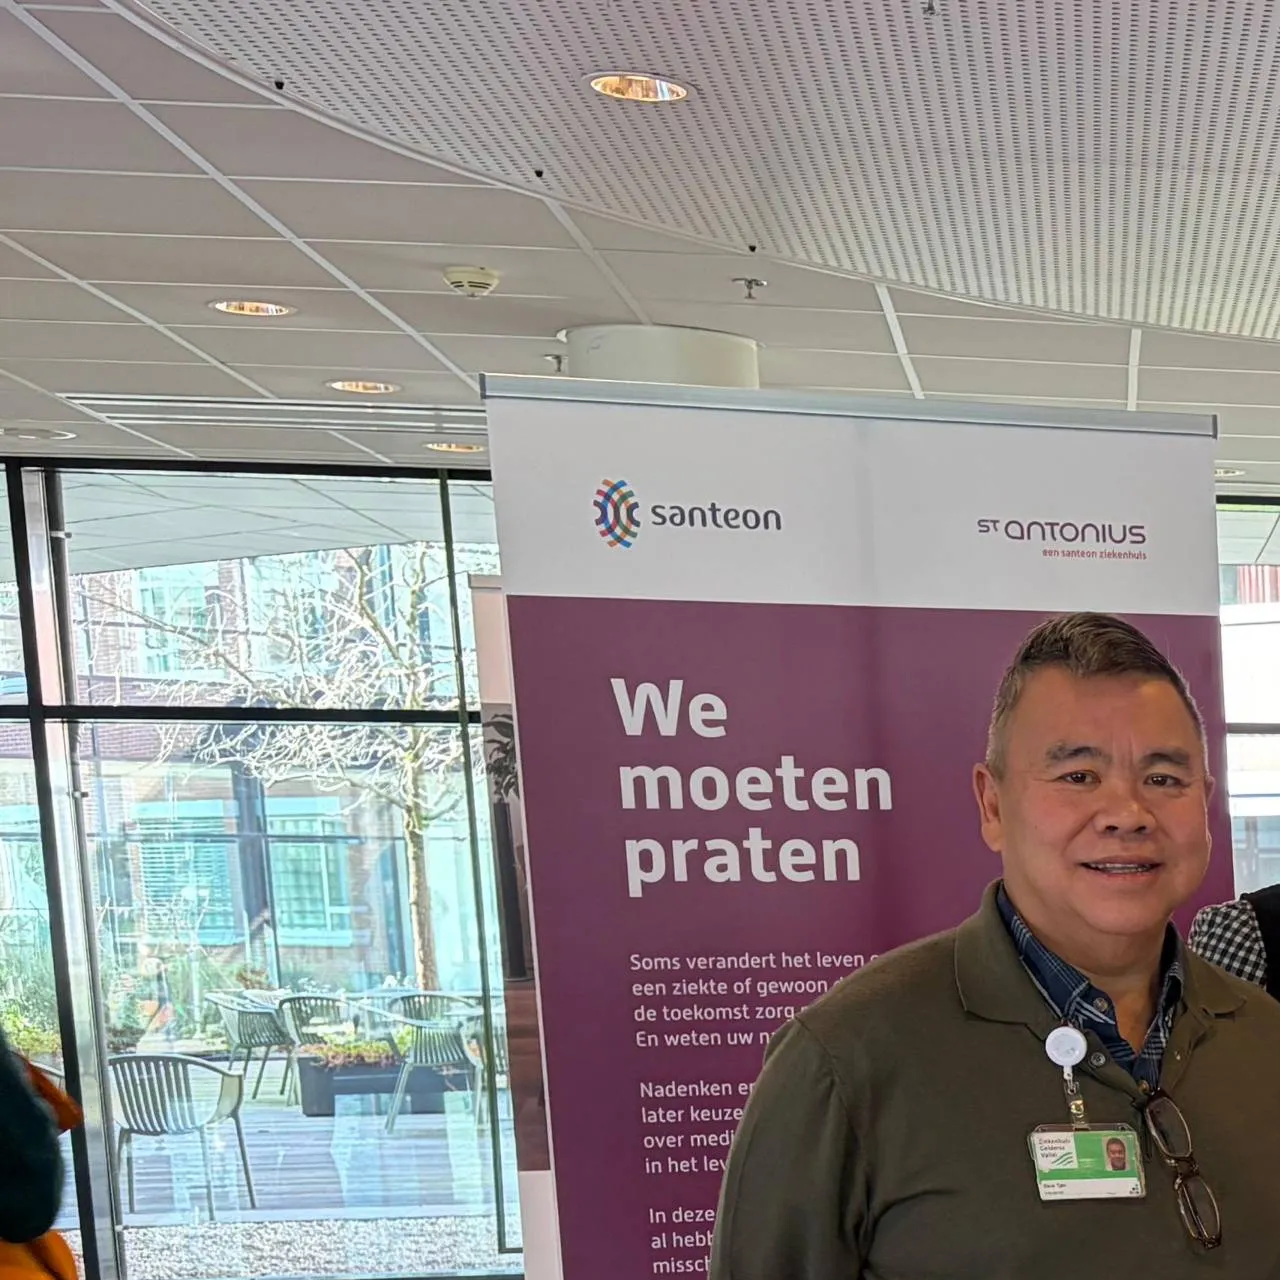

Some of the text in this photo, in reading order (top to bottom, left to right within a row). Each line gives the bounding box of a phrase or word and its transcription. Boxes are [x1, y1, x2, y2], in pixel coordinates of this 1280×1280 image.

[651, 502, 782, 531] santeon
[1042, 549, 1147, 560] een santeon ziekenhuis
[611, 677, 727, 737] We
[620, 754, 892, 811] moeten
[625, 825, 860, 898] praten
[630, 954, 681, 970] Soms
[686, 953, 776, 969] verandert
[782, 953, 811, 967] het
[816, 952, 864, 967] leven
[632, 982, 666, 996] een
[672, 979, 727, 995] ziekte
[733, 978, 753, 994] of
[757, 980, 828, 996] gewoon
[634, 1004, 795, 1022] de toekomst zorg
[636, 1032, 658, 1047] En
[665, 1032, 721, 1046] weten
[727, 1031, 753, 1044] uw
[640, 1081, 732, 1098] Nadenken
[641, 1105, 743, 1123] later keuze
[644, 1134, 683, 1148] over
[645, 1158, 662, 1173] in
[668, 1156, 698, 1172] het
[649, 1207, 715, 1223] In deze
[651, 1233, 666, 1249] al
